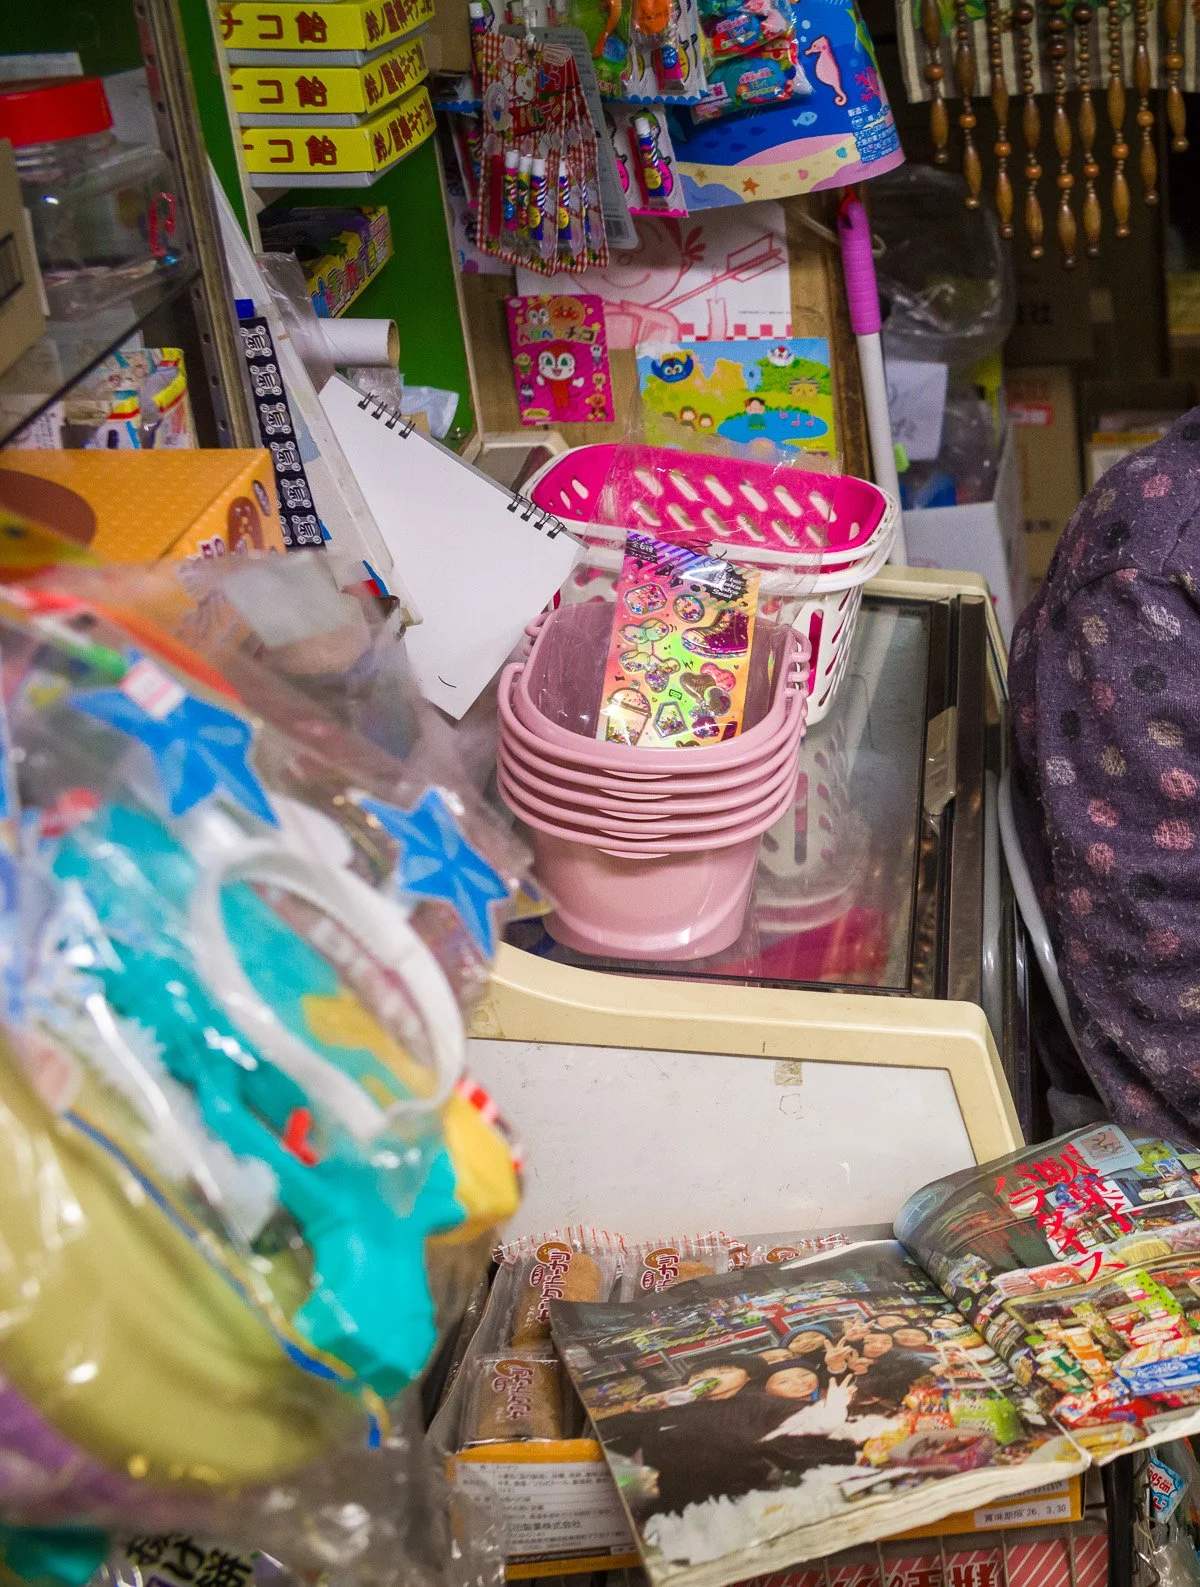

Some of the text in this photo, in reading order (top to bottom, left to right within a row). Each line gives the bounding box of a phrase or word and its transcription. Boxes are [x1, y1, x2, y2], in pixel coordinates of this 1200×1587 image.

[994, 1164, 1128, 1285] パラダイス
[1032, 1143, 1143, 1233] 駄菓子
[1046, 1503, 1067, 1514] 3.30
